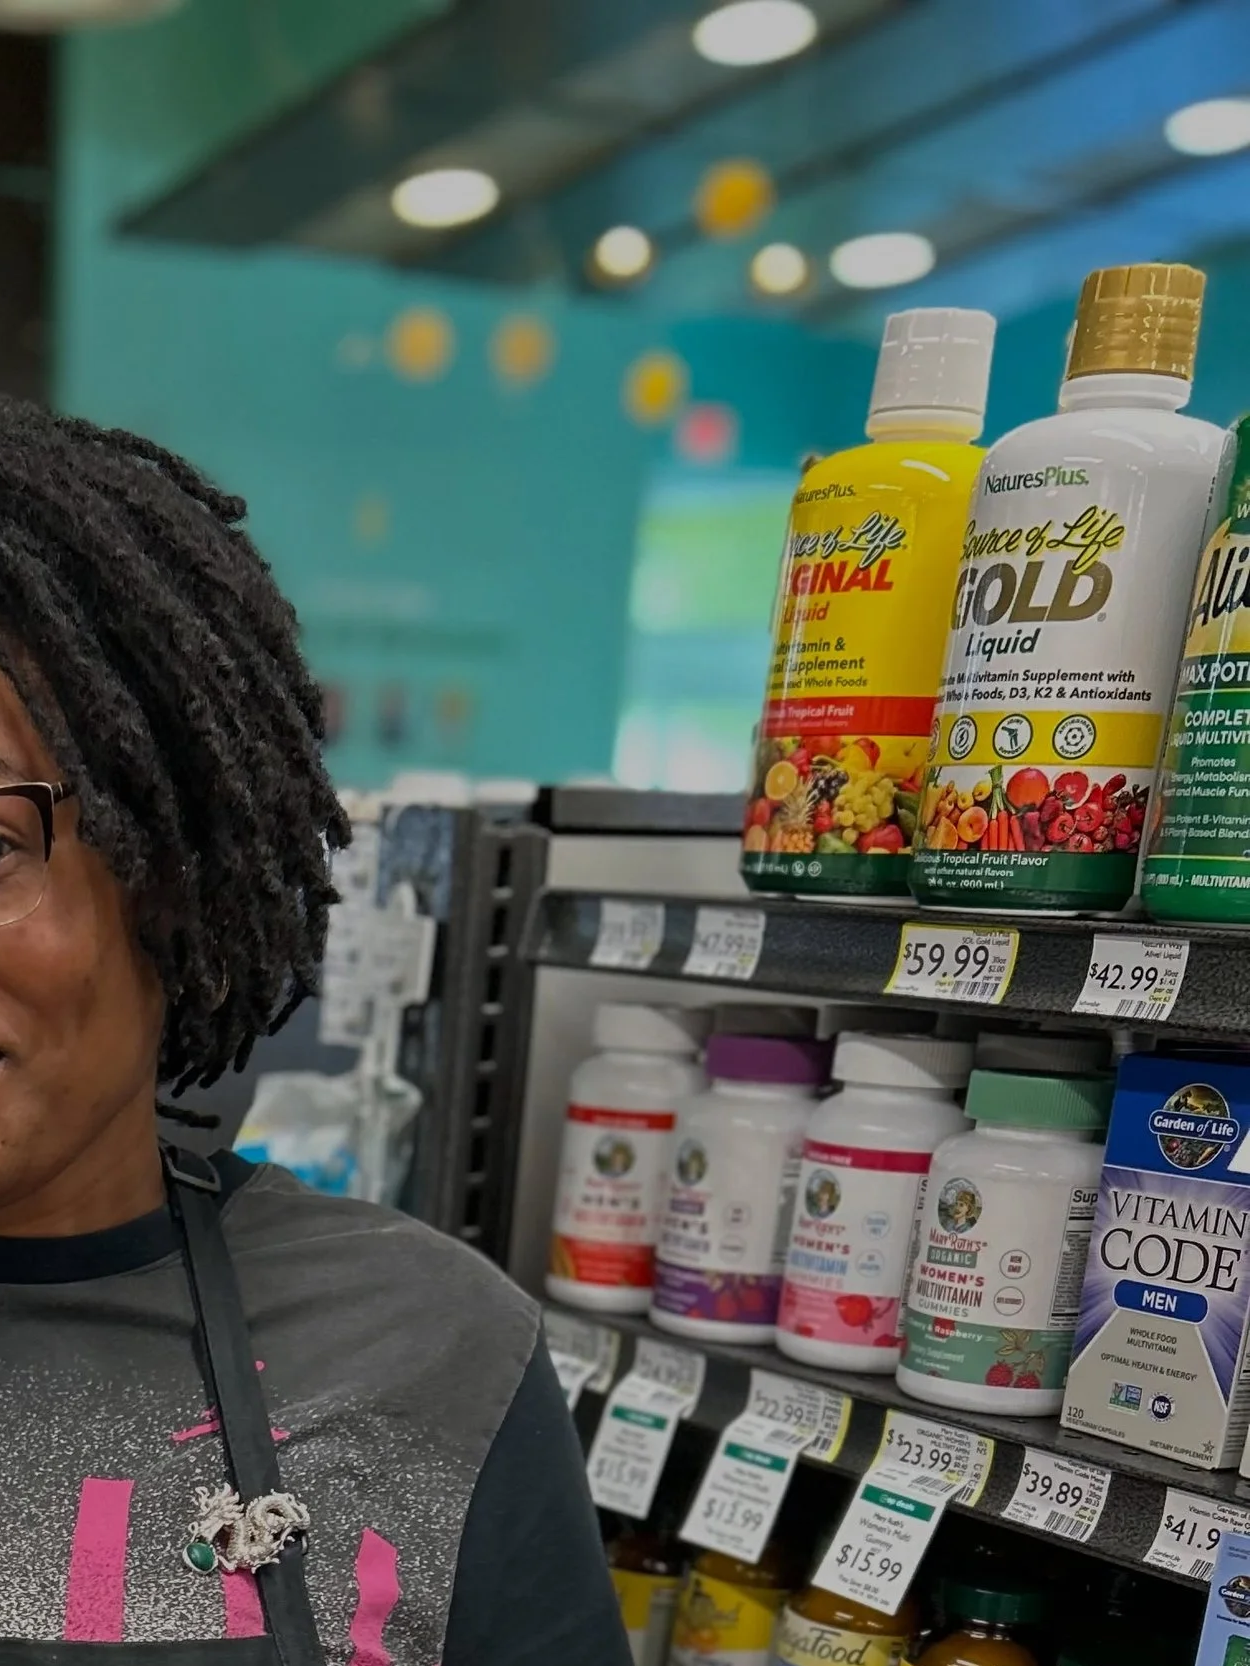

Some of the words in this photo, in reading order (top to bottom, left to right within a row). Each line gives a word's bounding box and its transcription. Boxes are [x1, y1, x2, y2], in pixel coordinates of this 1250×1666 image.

[838, 511, 906, 569] Life
[960, 520, 1023, 560] Source
[1025, 521, 1052, 556] of
[1047, 505, 1125, 571] Life
[792, 559, 894, 596] GINAL
[951, 560, 1113, 630] GOLD
[834, 637, 845, 651] &
[965, 628, 1041, 662] Liquid
[836, 677, 867, 687] Foods
[1022, 669, 1103, 685] Supplement
[1107, 670, 1135, 683] with
[972, 688, 1005, 701] Foods,
[1009, 688, 1030, 700] D3,
[1034, 687, 1052, 698] K2
[1056, 688, 1066, 698] &
[1070, 687, 1151, 701] Antioxidants
[826, 705, 854, 716] Fruit
[1191, 757, 1236, 768] Promotes
[1192, 786, 1226, 798] Muscle
[943, 853, 979, 866] Tropical
[982, 854, 1008, 864] Fruit
[1011, 854, 1048, 866] Flavor
[956, 868, 982, 876] natural
[985, 868, 1013, 876] flavors
[903, 943, 989, 978] $59.99
[1089, 962, 1158, 991] $42.99
[1153, 1115, 1194, 1131] Garden
[1197, 1117, 1208, 1133] of
[1211, 1123, 1235, 1138] Life
[1112, 1190, 1248, 1239] VITAMIN
[930, 1248, 971, 1264] ORGANIC
[1100, 1228, 1242, 1294] CODE
[920, 1264, 985, 1287] WOMEN'S
[917, 1278, 983, 1307] MULTIVITAMIN
[1142, 1290, 1177, 1312] MEN
[918, 1299, 969, 1318] GUMMIES
[1127, 1338, 1177, 1355] MULTIVITAMIN
[1130, 1327, 1155, 1340] WHOLE
[1157, 1333, 1177, 1345] FOOD
[1101, 1353, 1130, 1367] OPTIMAL
[1132, 1361, 1158, 1373] HEALTH
[1160, 1366, 1165, 1374] &
[1067, 1406, 1084, 1419] 120
[1153, 1401, 1169, 1413] NSF
[897, 1434, 952, 1472] $23.99
[1174, 1445, 1213, 1462] SUPPLEMENT
[1023, 1463, 1083, 1509] $39.89
[1188, 1505, 1211, 1520] Vitamin
[1212, 1514, 1228, 1525] Code
[859, 1517, 892, 1535] Women's
[893, 1528, 911, 1542] Multi
[1164, 1514, 1221, 1551] $41.9
[865, 1534, 893, 1550] Gummy
[835, 1543, 902, 1582] $15.99
